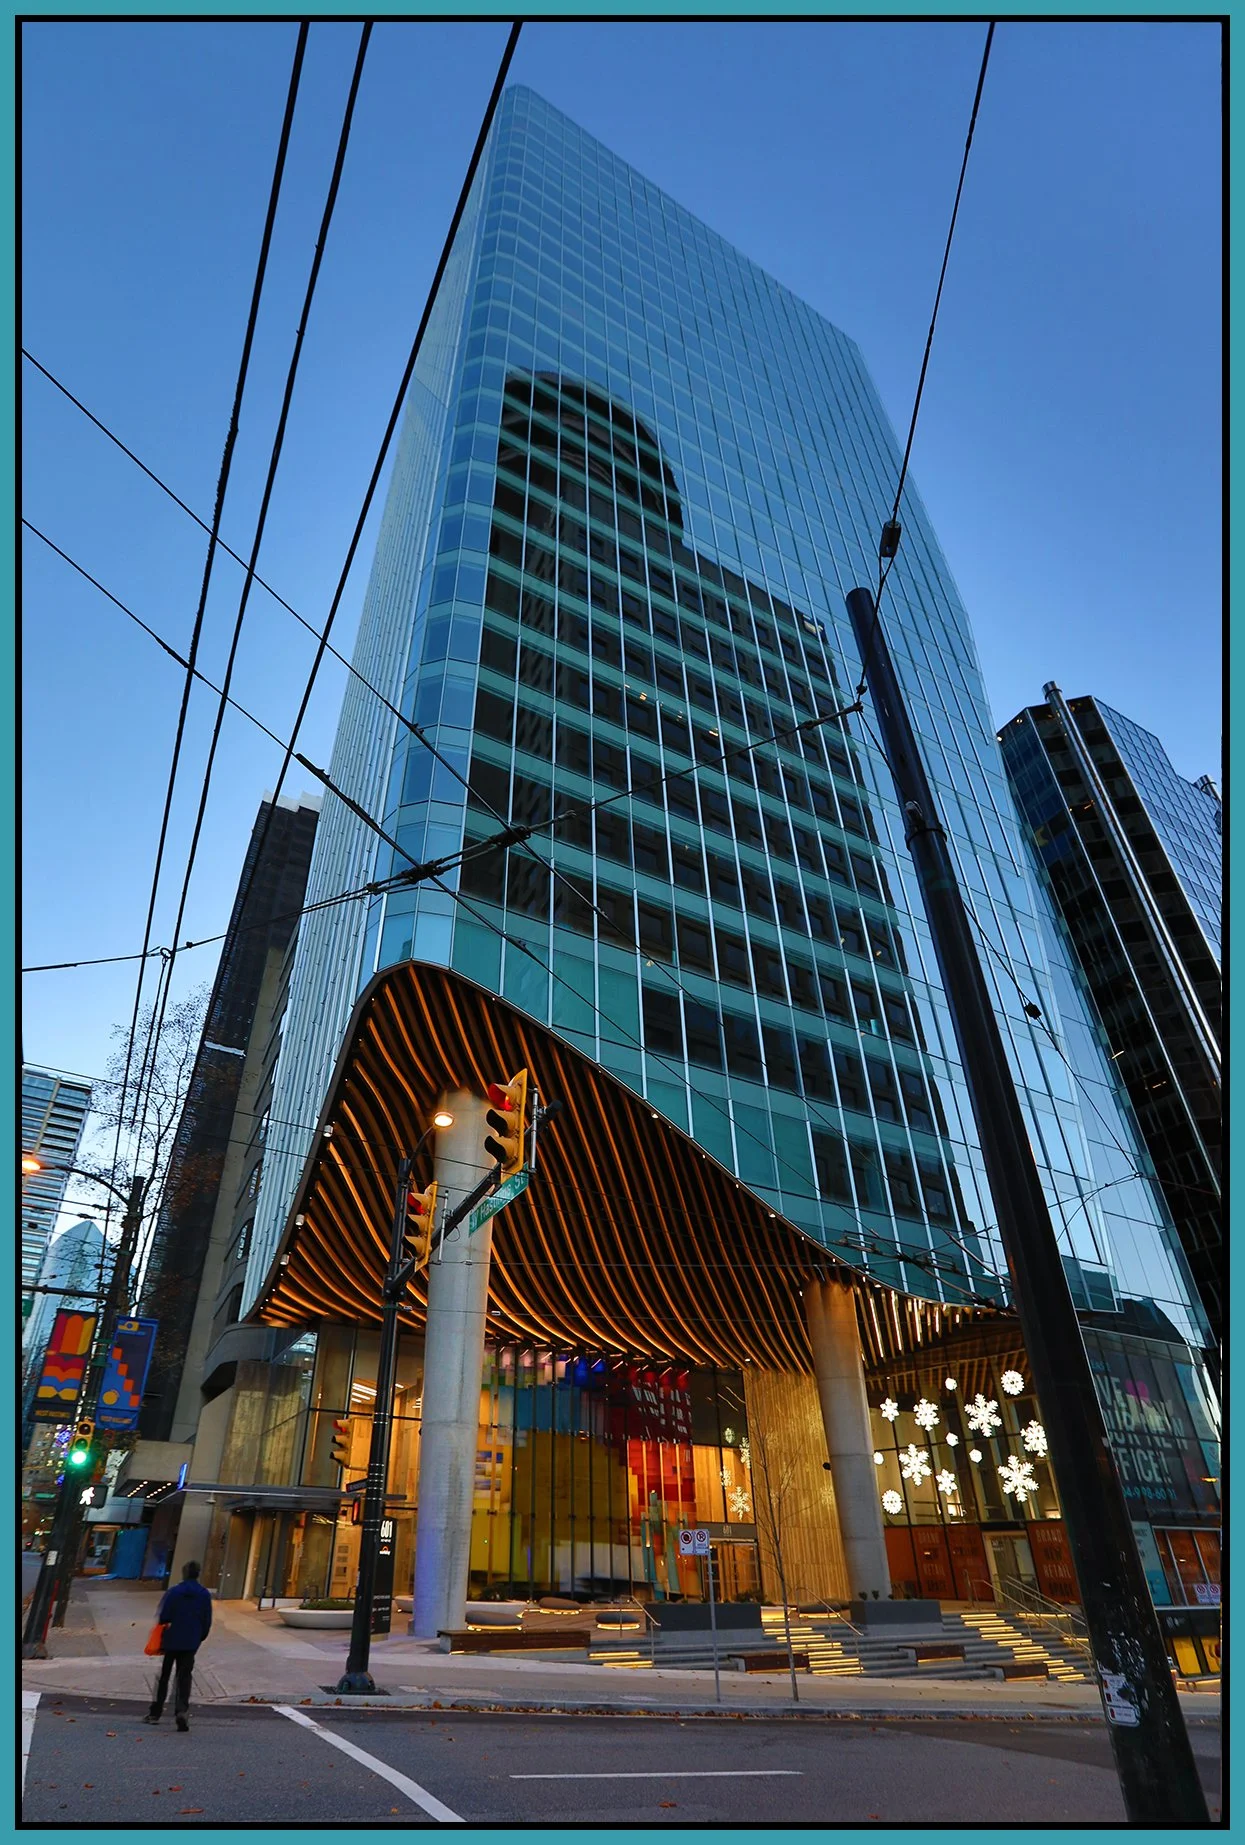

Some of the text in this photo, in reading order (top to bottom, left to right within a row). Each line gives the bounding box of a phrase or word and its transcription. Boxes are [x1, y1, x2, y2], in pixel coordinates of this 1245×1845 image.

[514, 1171, 524, 1189] St
[1095, 1373, 1127, 1410] VE
[1140, 1412, 1188, 1450] NEW
[380, 1520, 393, 1538] 601
[1035, 1528, 1063, 1543] BRAND
[1043, 1564, 1072, 1578] RETAIL
